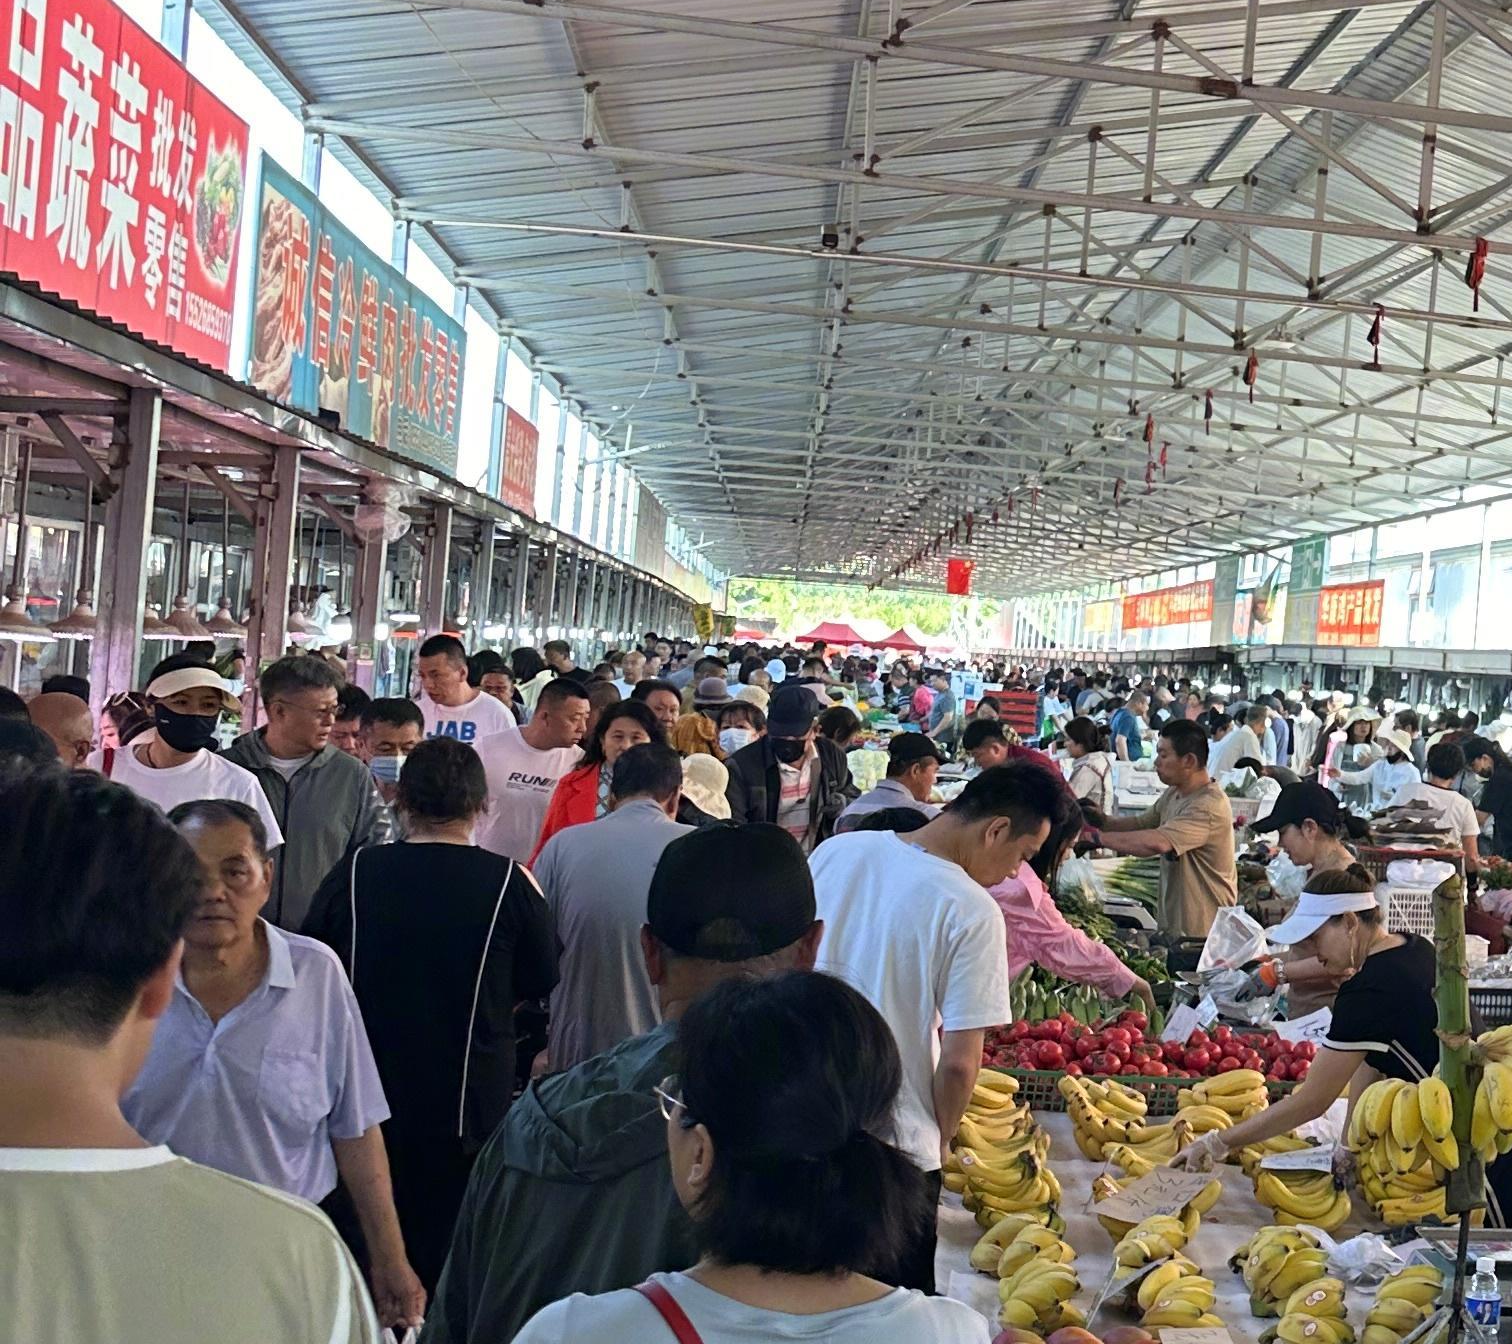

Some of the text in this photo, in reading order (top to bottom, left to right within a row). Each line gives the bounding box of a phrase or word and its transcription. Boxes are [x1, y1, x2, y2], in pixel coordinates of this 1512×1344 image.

[149, 89, 198, 215] 批发
[141, 203, 189, 323] 零售
[427, 720, 477, 740] JAB
